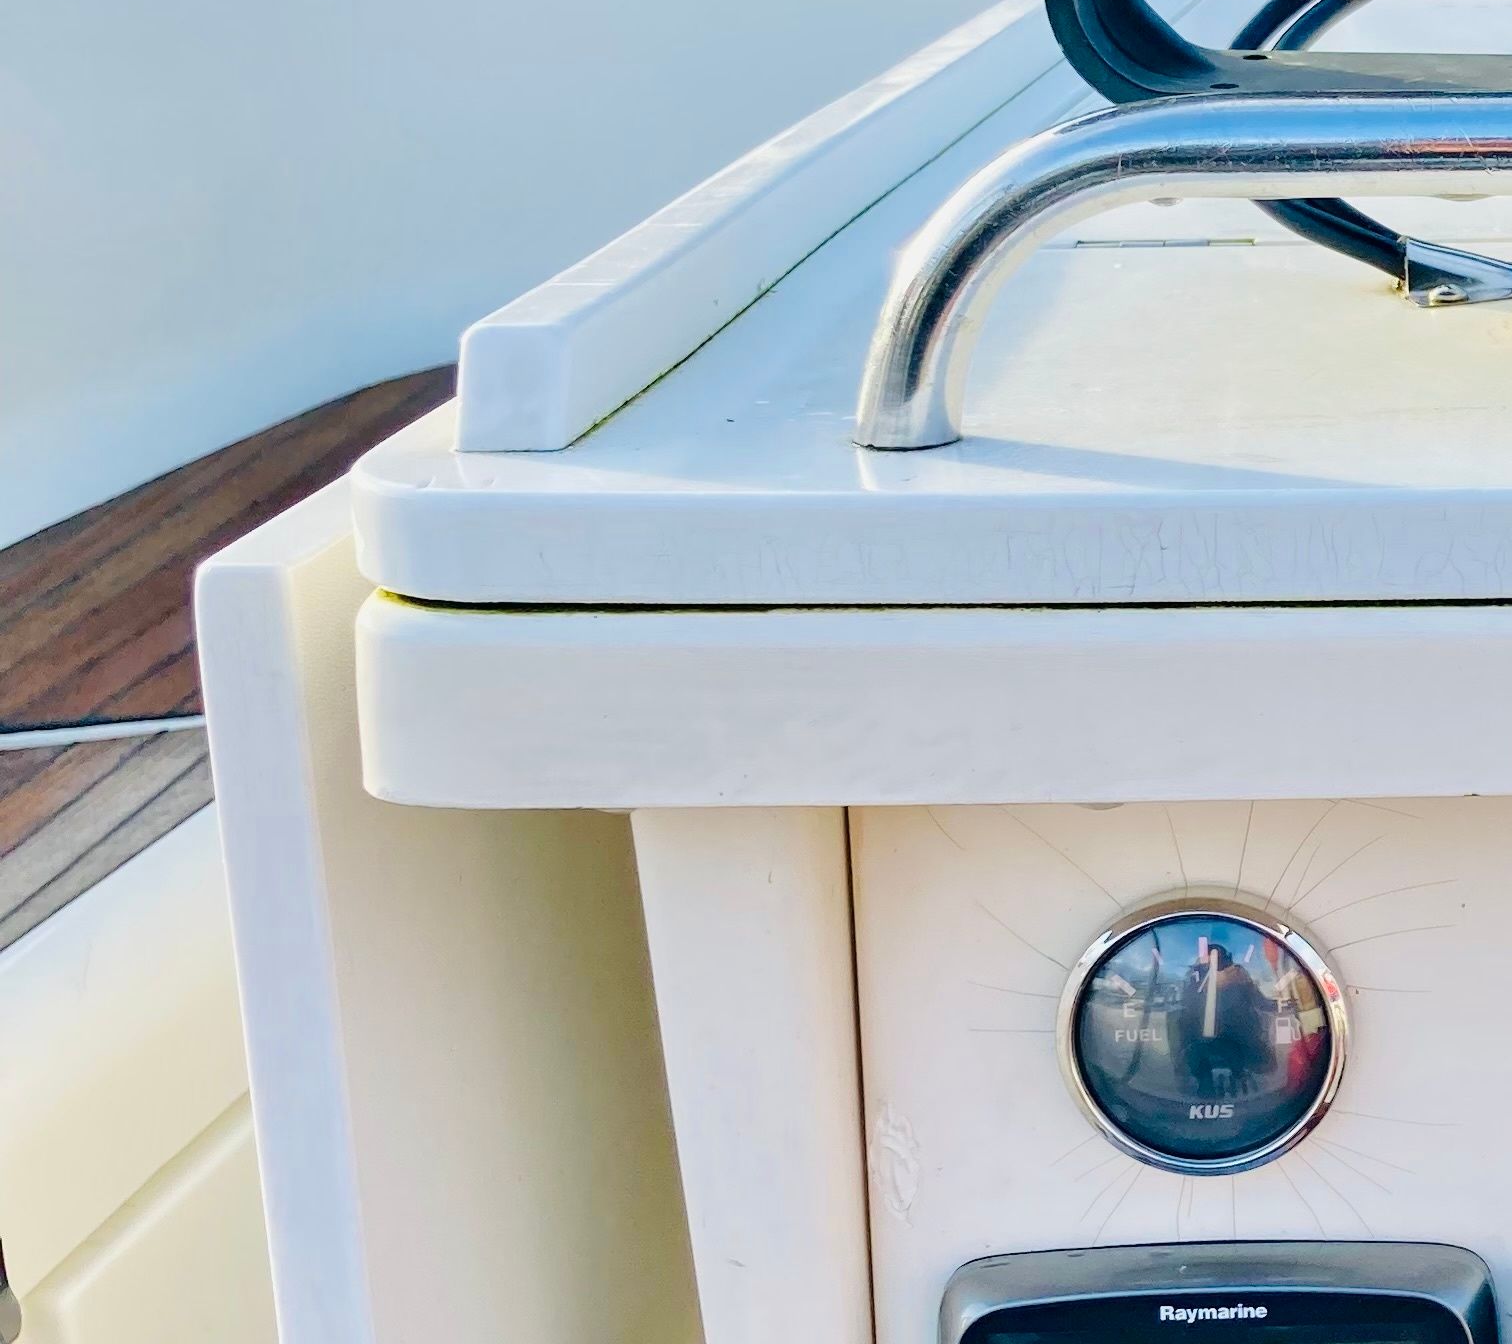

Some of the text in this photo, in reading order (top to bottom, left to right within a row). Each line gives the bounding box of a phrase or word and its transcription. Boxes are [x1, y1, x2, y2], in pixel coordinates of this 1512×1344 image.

[1123, 1003, 1137, 1018] E
[1115, 1029, 1161, 1042] FUEL
[1189, 1105, 1234, 1119] KUS
[1159, 1304, 1268, 1324] Raymarine
